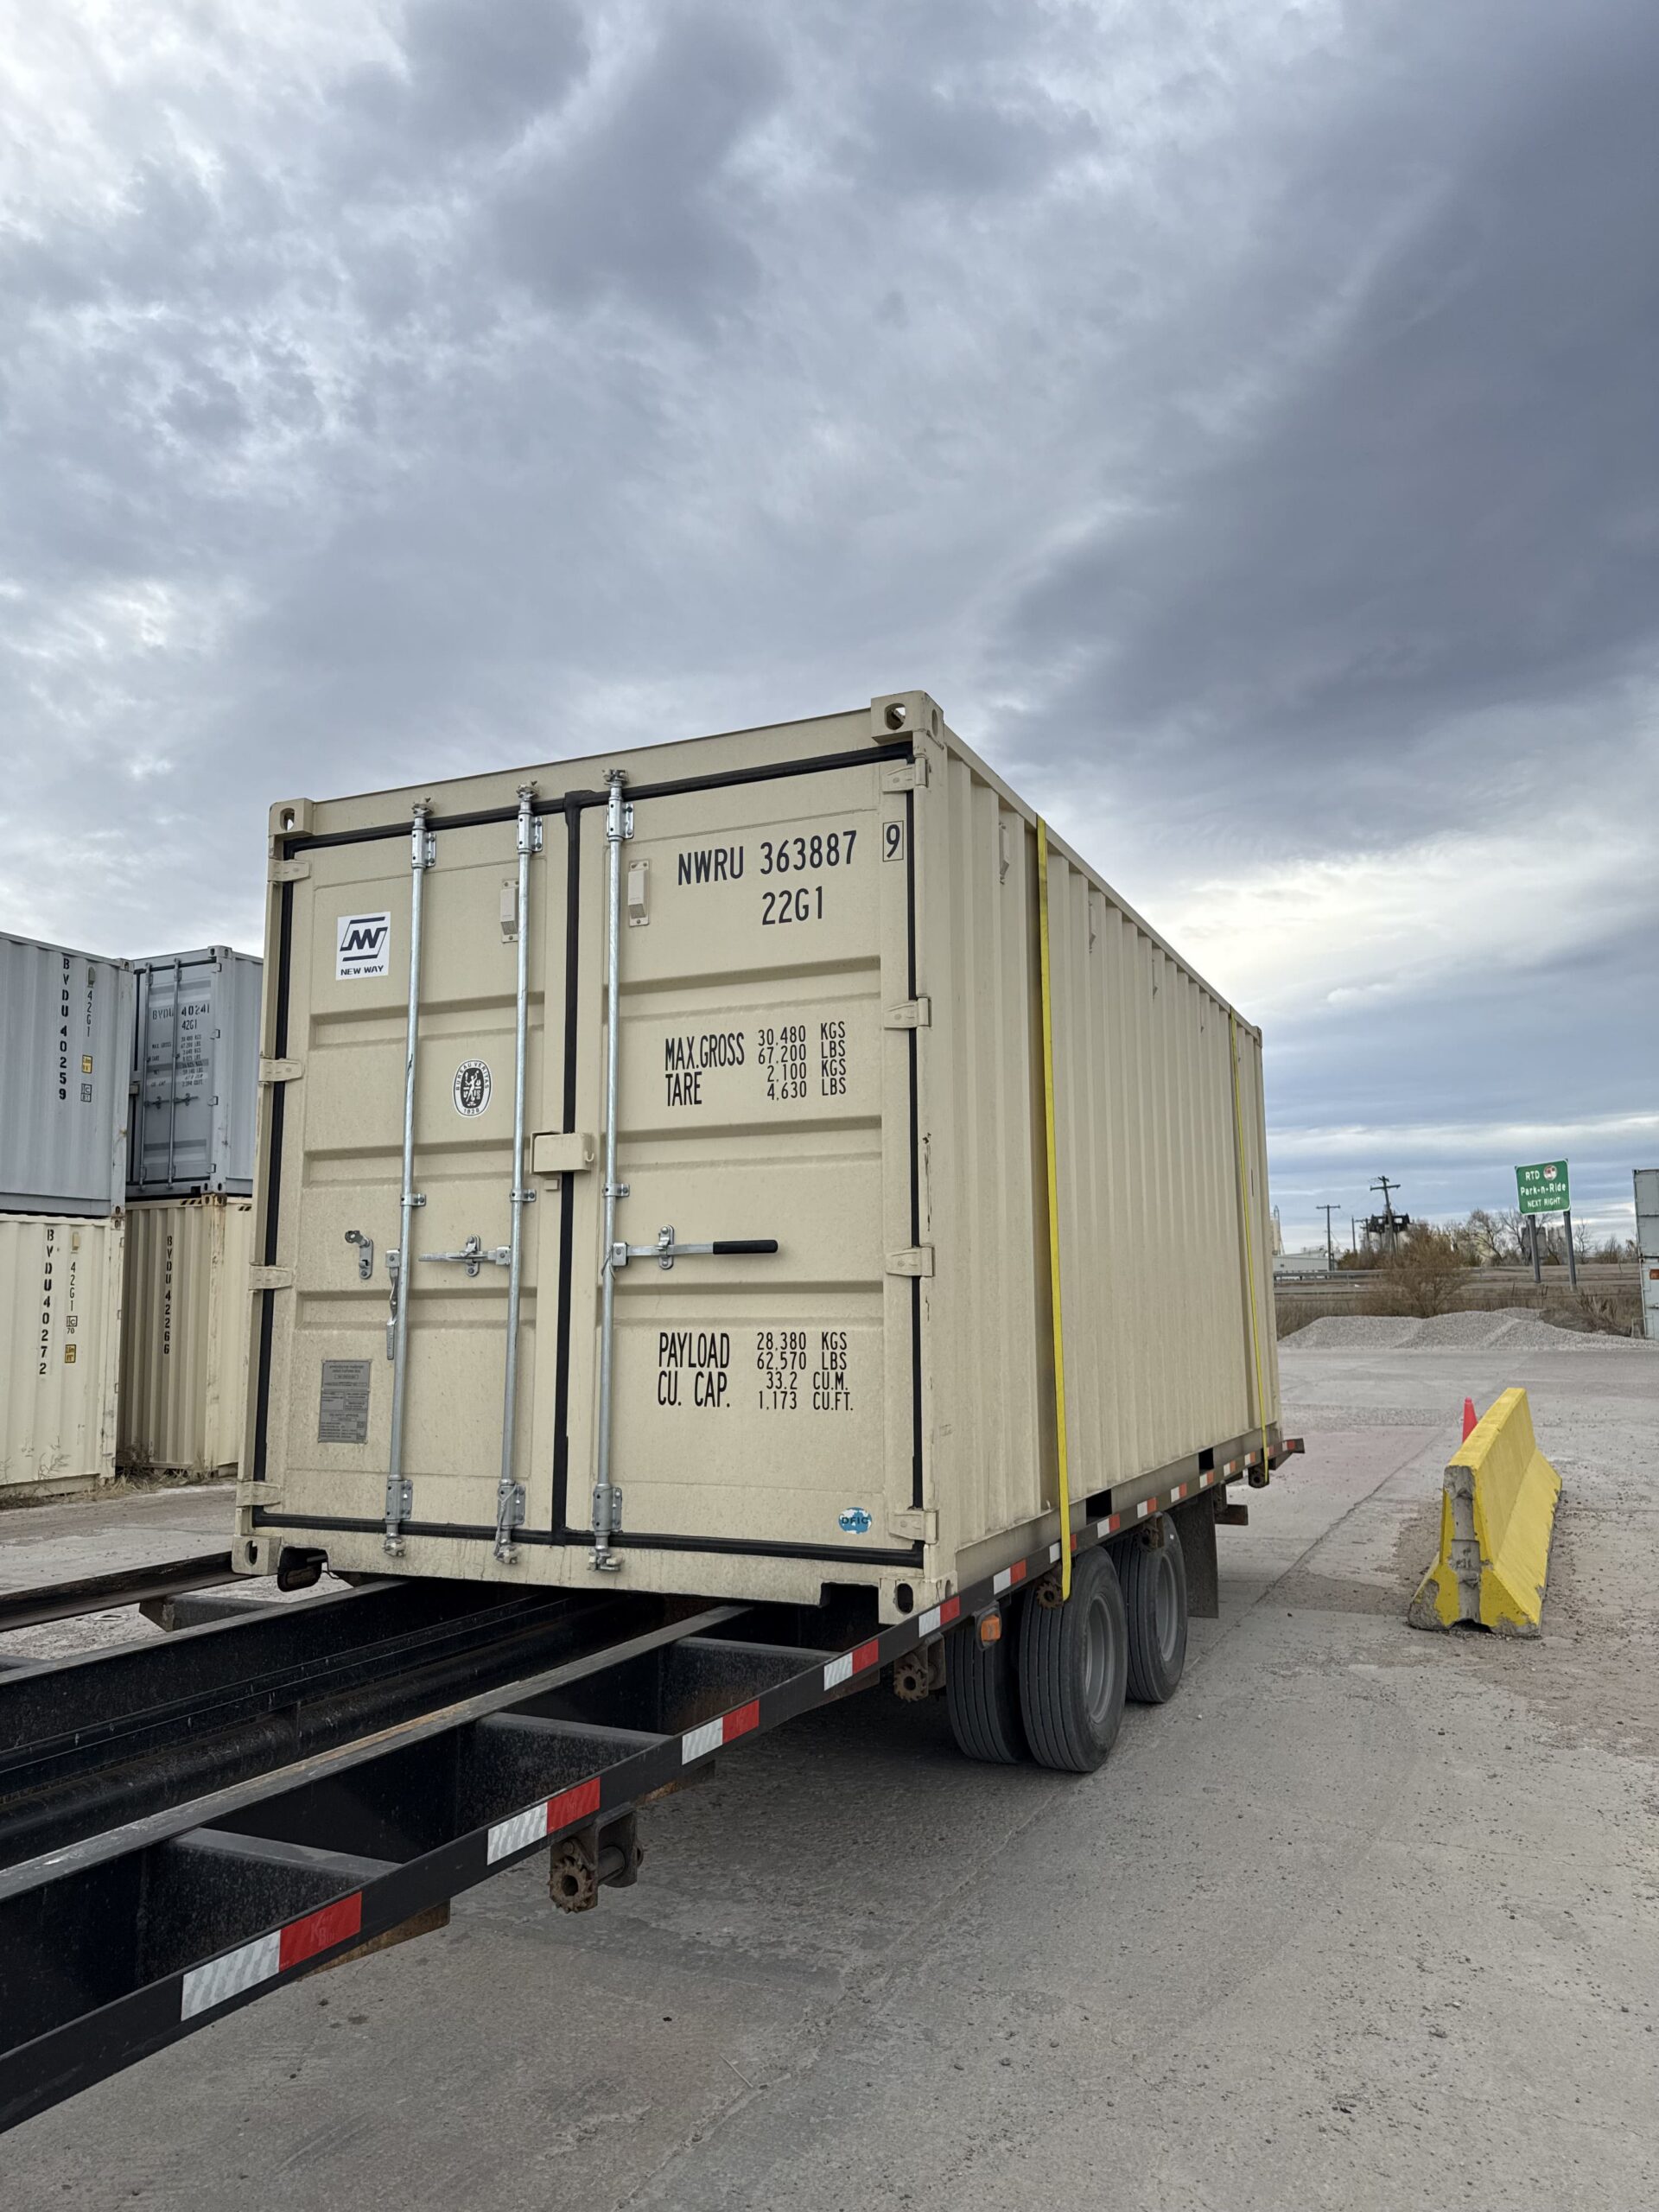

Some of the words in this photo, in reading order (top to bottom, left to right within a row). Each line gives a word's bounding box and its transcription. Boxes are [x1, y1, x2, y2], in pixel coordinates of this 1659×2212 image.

[678, 846, 745, 886] NWRU
[760, 830, 857, 874] 363887
[886, 823, 900, 859] 9
[761, 886, 823, 925] 22G1
[364, 964, 385, 974] WAY
[181, 1003, 209, 1016] 40241
[181, 1019, 198, 1031] 42G1
[664, 1031, 746, 1071] MAX.GROSS
[820, 1020, 846, 1040] KGS
[820, 1039, 846, 1059] LBS
[454, 1062, 473, 1091] BUREAU
[474, 1062, 490, 1089] VERITAS
[821, 1058, 847, 1077] KGS
[664, 1071, 702, 1107] TARE
[822, 1077, 848, 1096] LBS
[1525, 1170, 1541, 1182] RTD
[1520, 1182, 1567, 1197] Park-n-Ride
[1527, 1198, 1542, 1208] NEXT
[1544, 1197, 1560, 1206] RIGHT
[658, 1332, 730, 1369] PAYLOAD
[821, 1332, 848, 1351] KGS
[821, 1351, 848, 1370] LBS
[658, 1370, 683, 1407] CU.
[694, 1370, 731, 1408] CAP.
[766, 1371, 798, 1390] 33.2
[812, 1371, 849, 1391] CU.M.
[812, 1391, 855, 1411] CU.FT.
